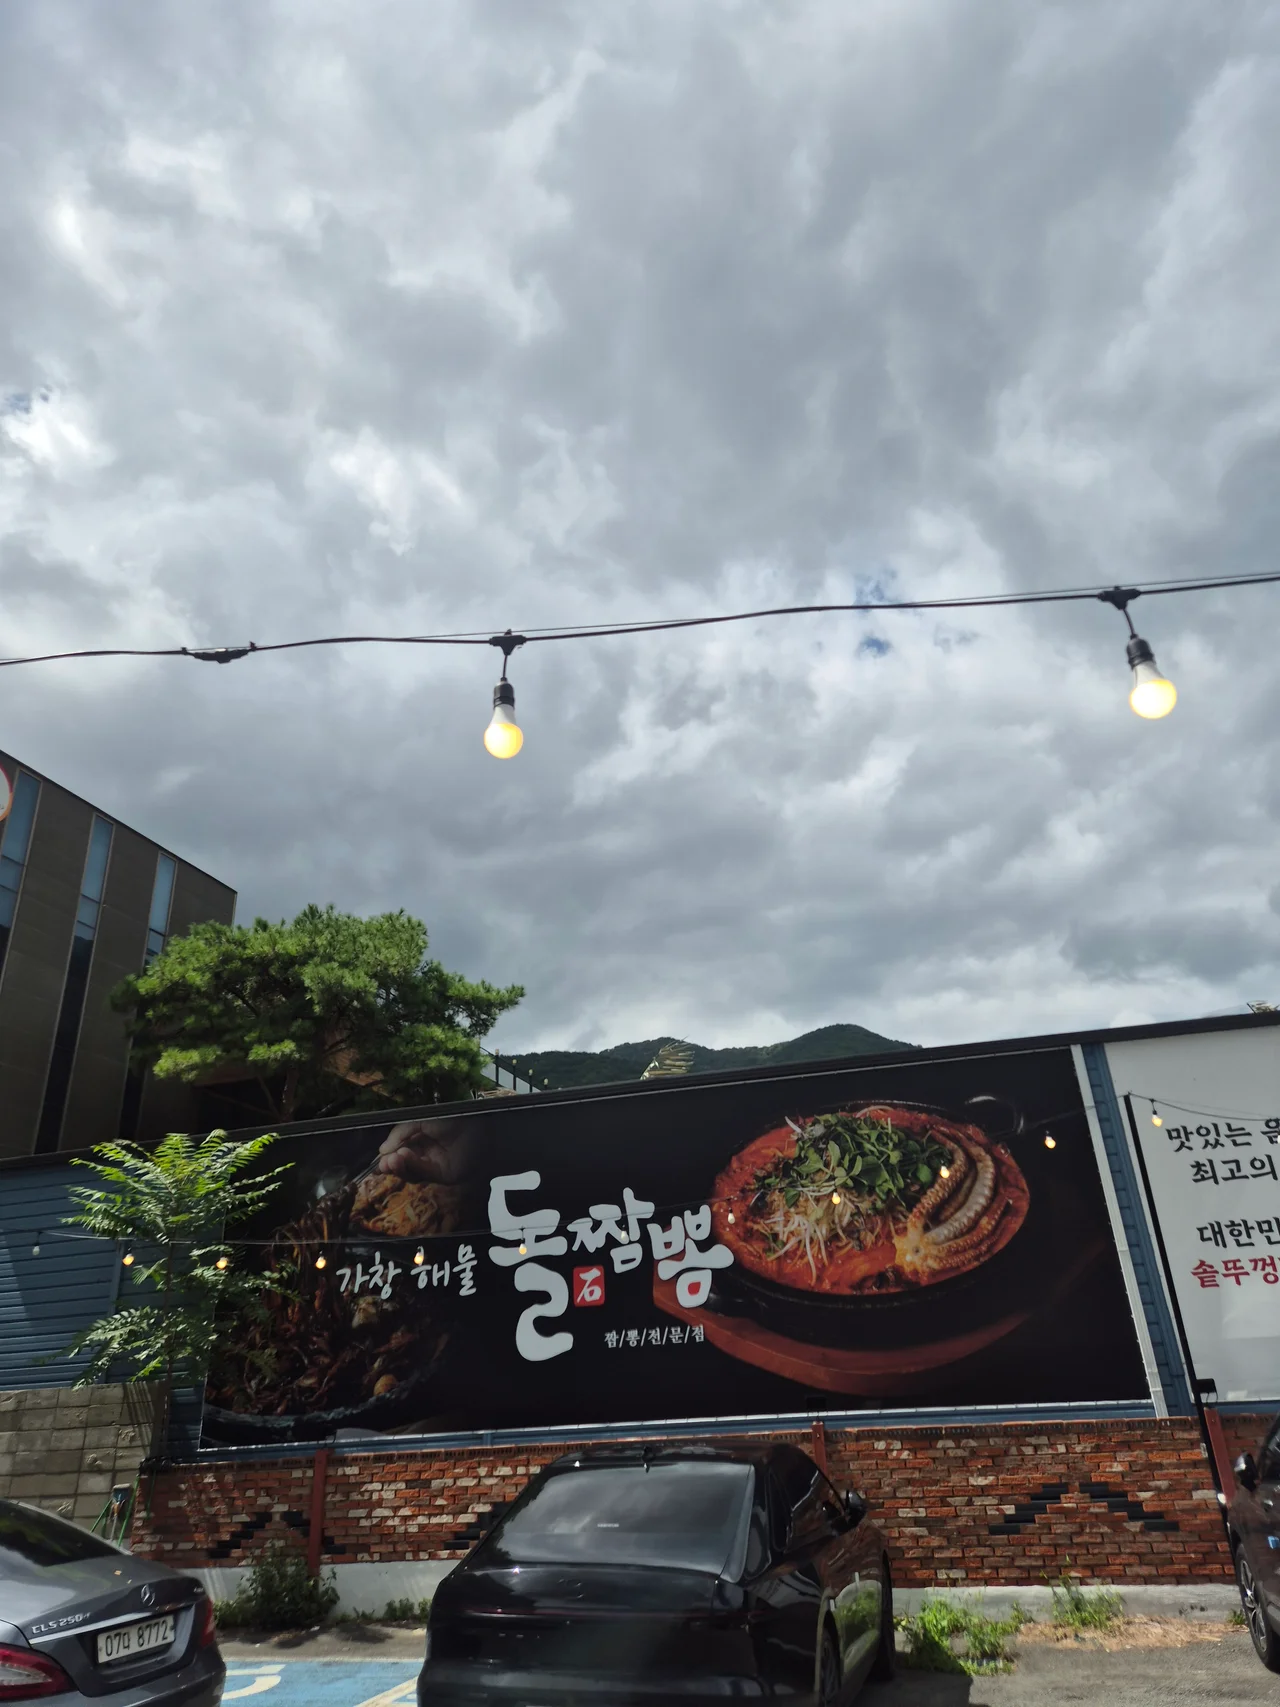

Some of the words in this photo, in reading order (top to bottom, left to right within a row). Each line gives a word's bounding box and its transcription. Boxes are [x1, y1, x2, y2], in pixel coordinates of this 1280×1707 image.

[1165, 1122, 1252, 1152] 맛있는
[1189, 1153, 1279, 1185] 최고의
[336, 1250, 402, 1300] 가창
[410, 1243, 478, 1297] 해물
[1191, 1254, 1280, 1289] 솥뚜껑
[137, 1619, 168, 1648] 8772
